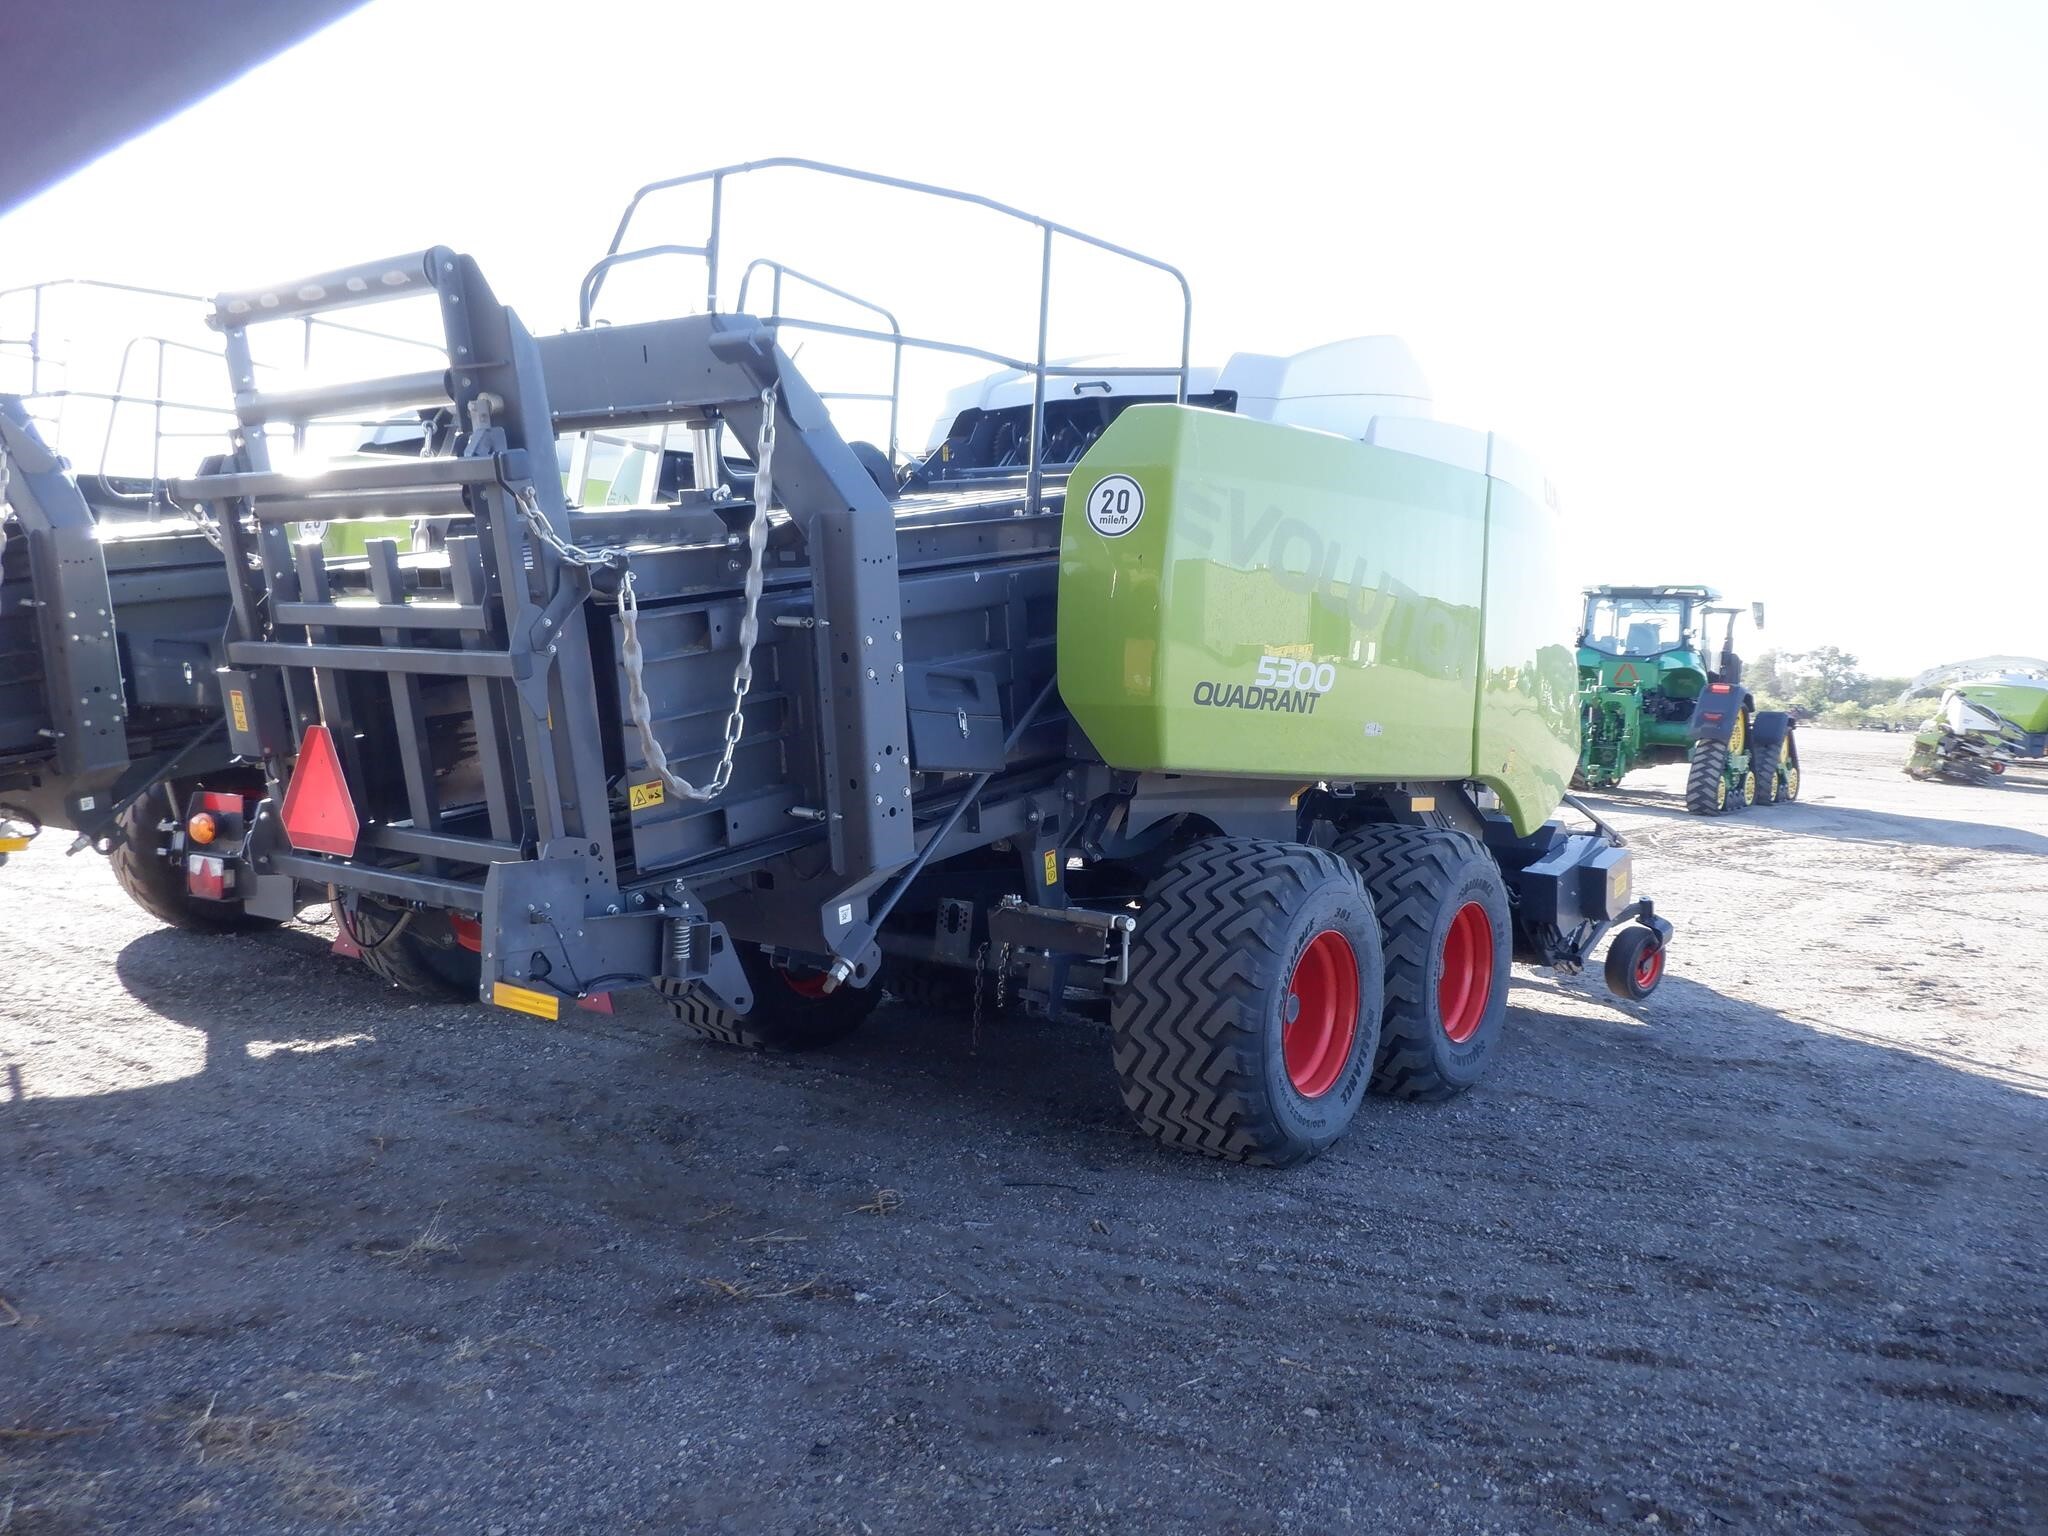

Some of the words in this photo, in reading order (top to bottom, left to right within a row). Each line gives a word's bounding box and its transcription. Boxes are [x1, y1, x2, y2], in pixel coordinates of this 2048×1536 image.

[1101, 489, 1130, 514] 20
[1099, 515, 1128, 525] mile/h
[1254, 655, 1336, 693] 5300
[1193, 681, 1321, 714] QUADRANT
